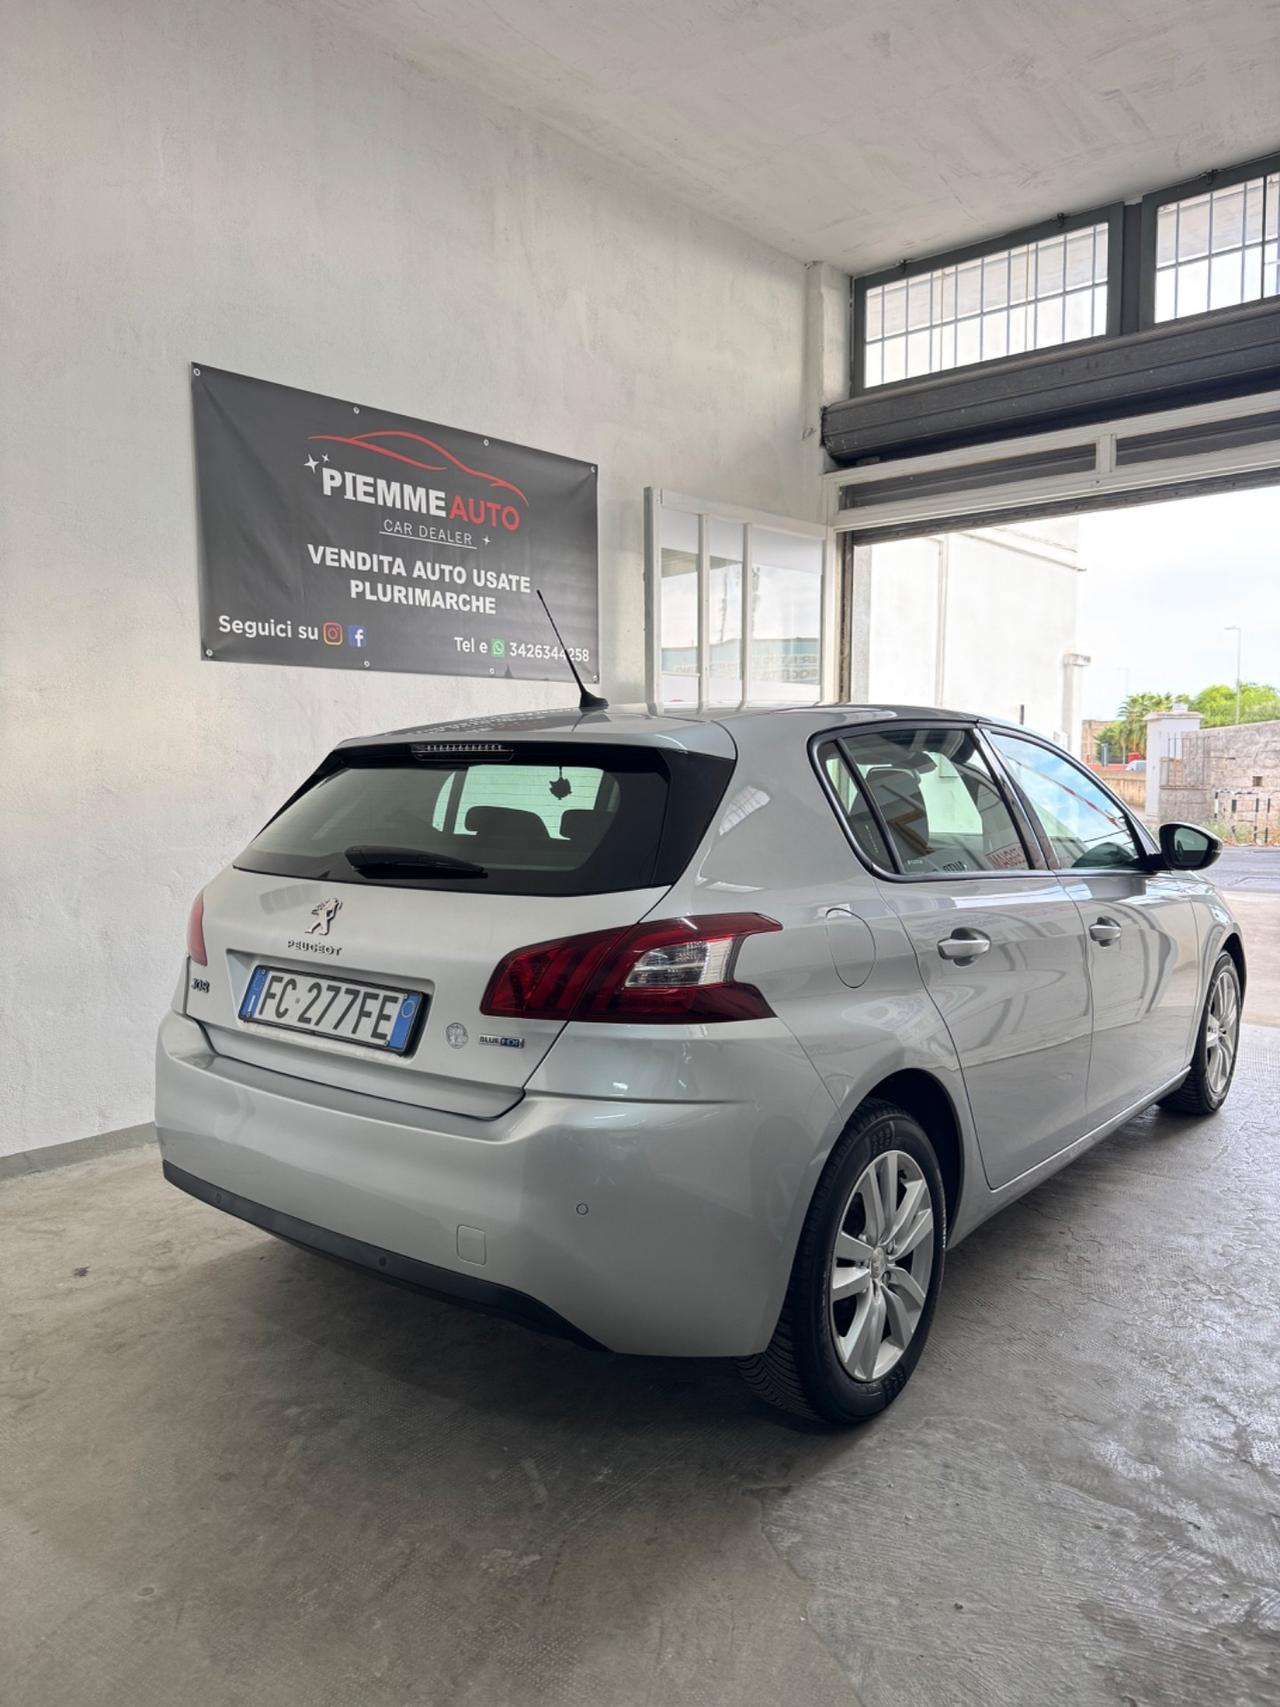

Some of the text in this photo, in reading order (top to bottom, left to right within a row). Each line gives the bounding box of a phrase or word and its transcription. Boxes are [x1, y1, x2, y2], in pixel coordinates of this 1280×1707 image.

[383, 518, 473, 545] CAR DEALER
[307, 543, 531, 594] VENDITA AUTO USATE
[350, 579, 497, 615] PLURIMARCHE
[218, 614, 319, 642] Seguici su
[454, 637, 476, 653] Tel
[479, 642, 488, 654] e
[287, 939, 342, 956] PEUGEOT
